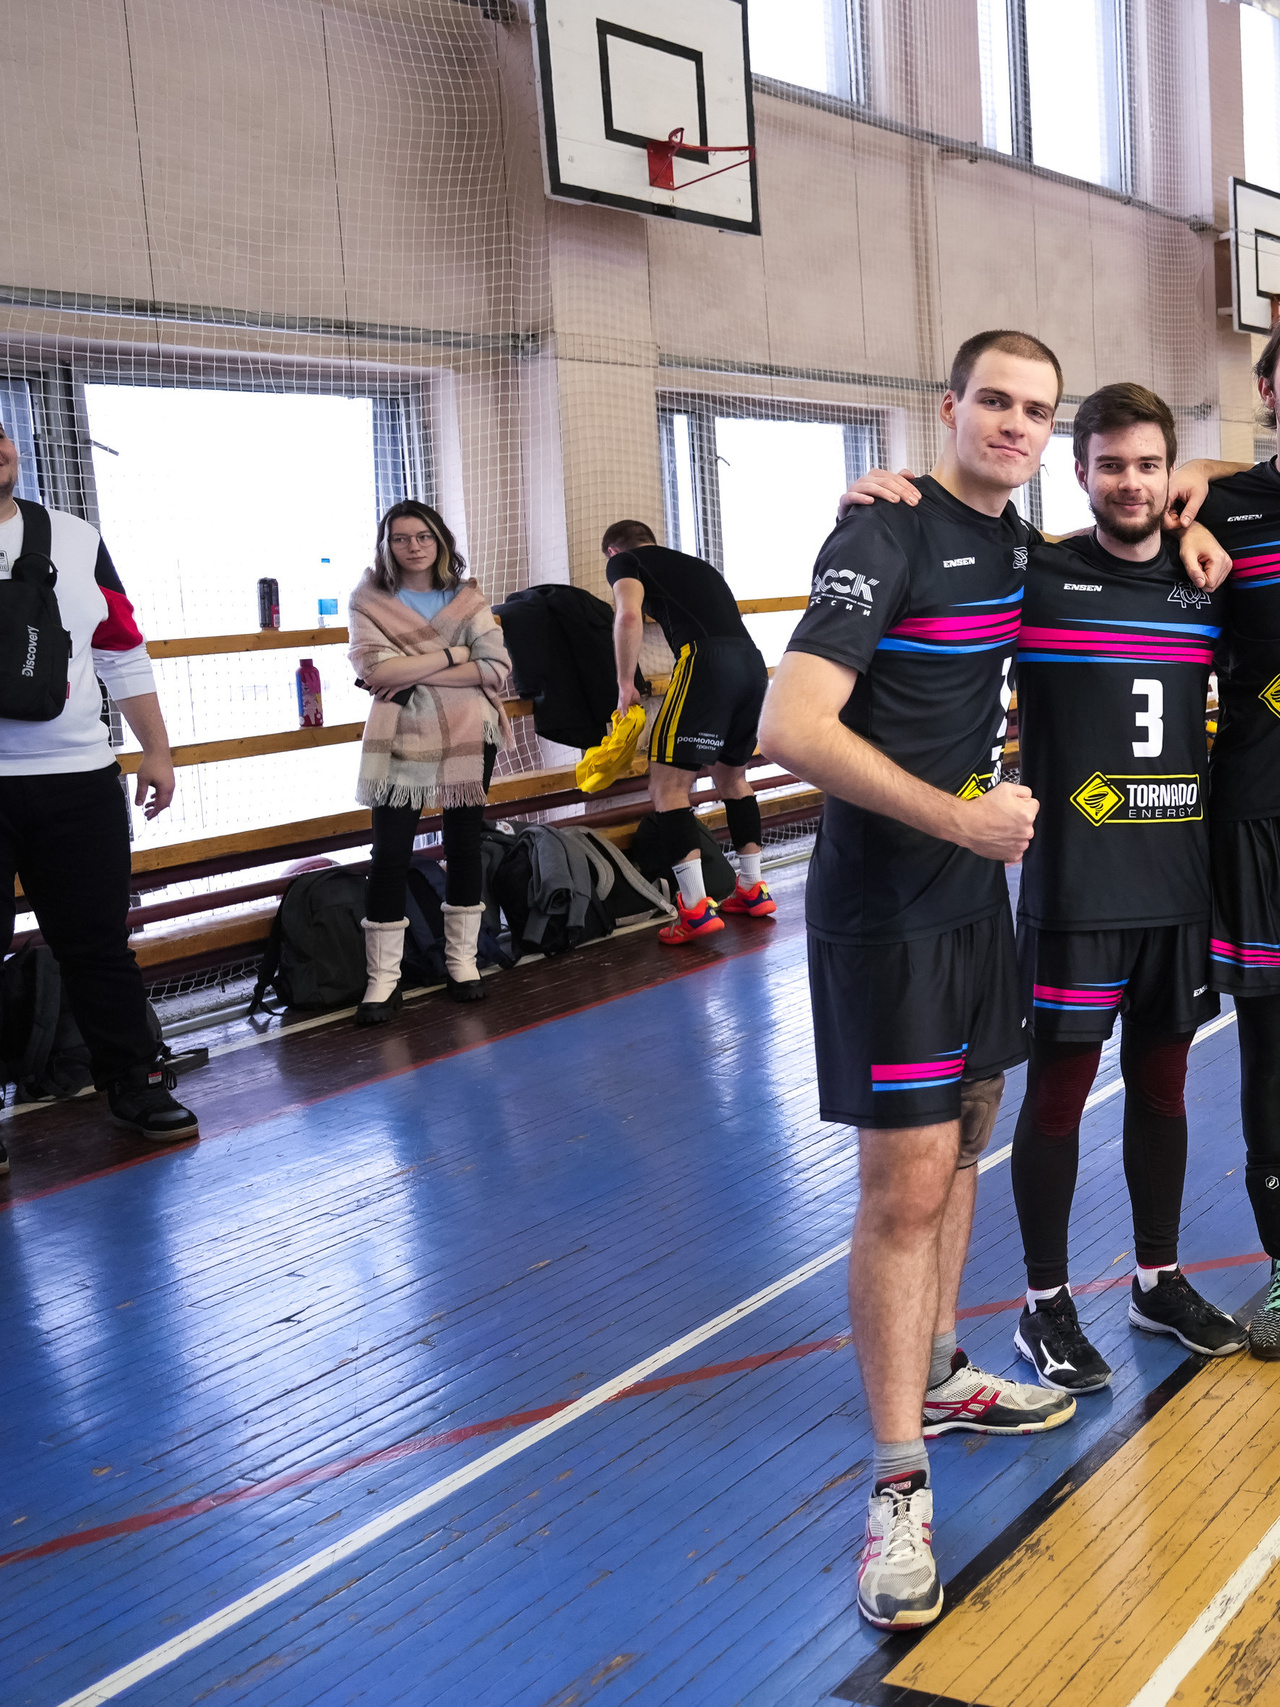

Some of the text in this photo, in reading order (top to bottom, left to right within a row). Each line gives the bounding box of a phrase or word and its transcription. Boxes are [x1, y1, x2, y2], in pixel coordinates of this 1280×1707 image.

[1227, 514, 1263, 522] ENSEN
[943, 556, 976, 569] ENSEN
[1063, 583, 1103, 592] ENSEN
[21, 624, 40, 678] Discovery
[1131, 678, 1164, 758] 3
[1126, 783, 1198, 808] TORNADO
[1128, 806, 1195, 819] ENERGY
